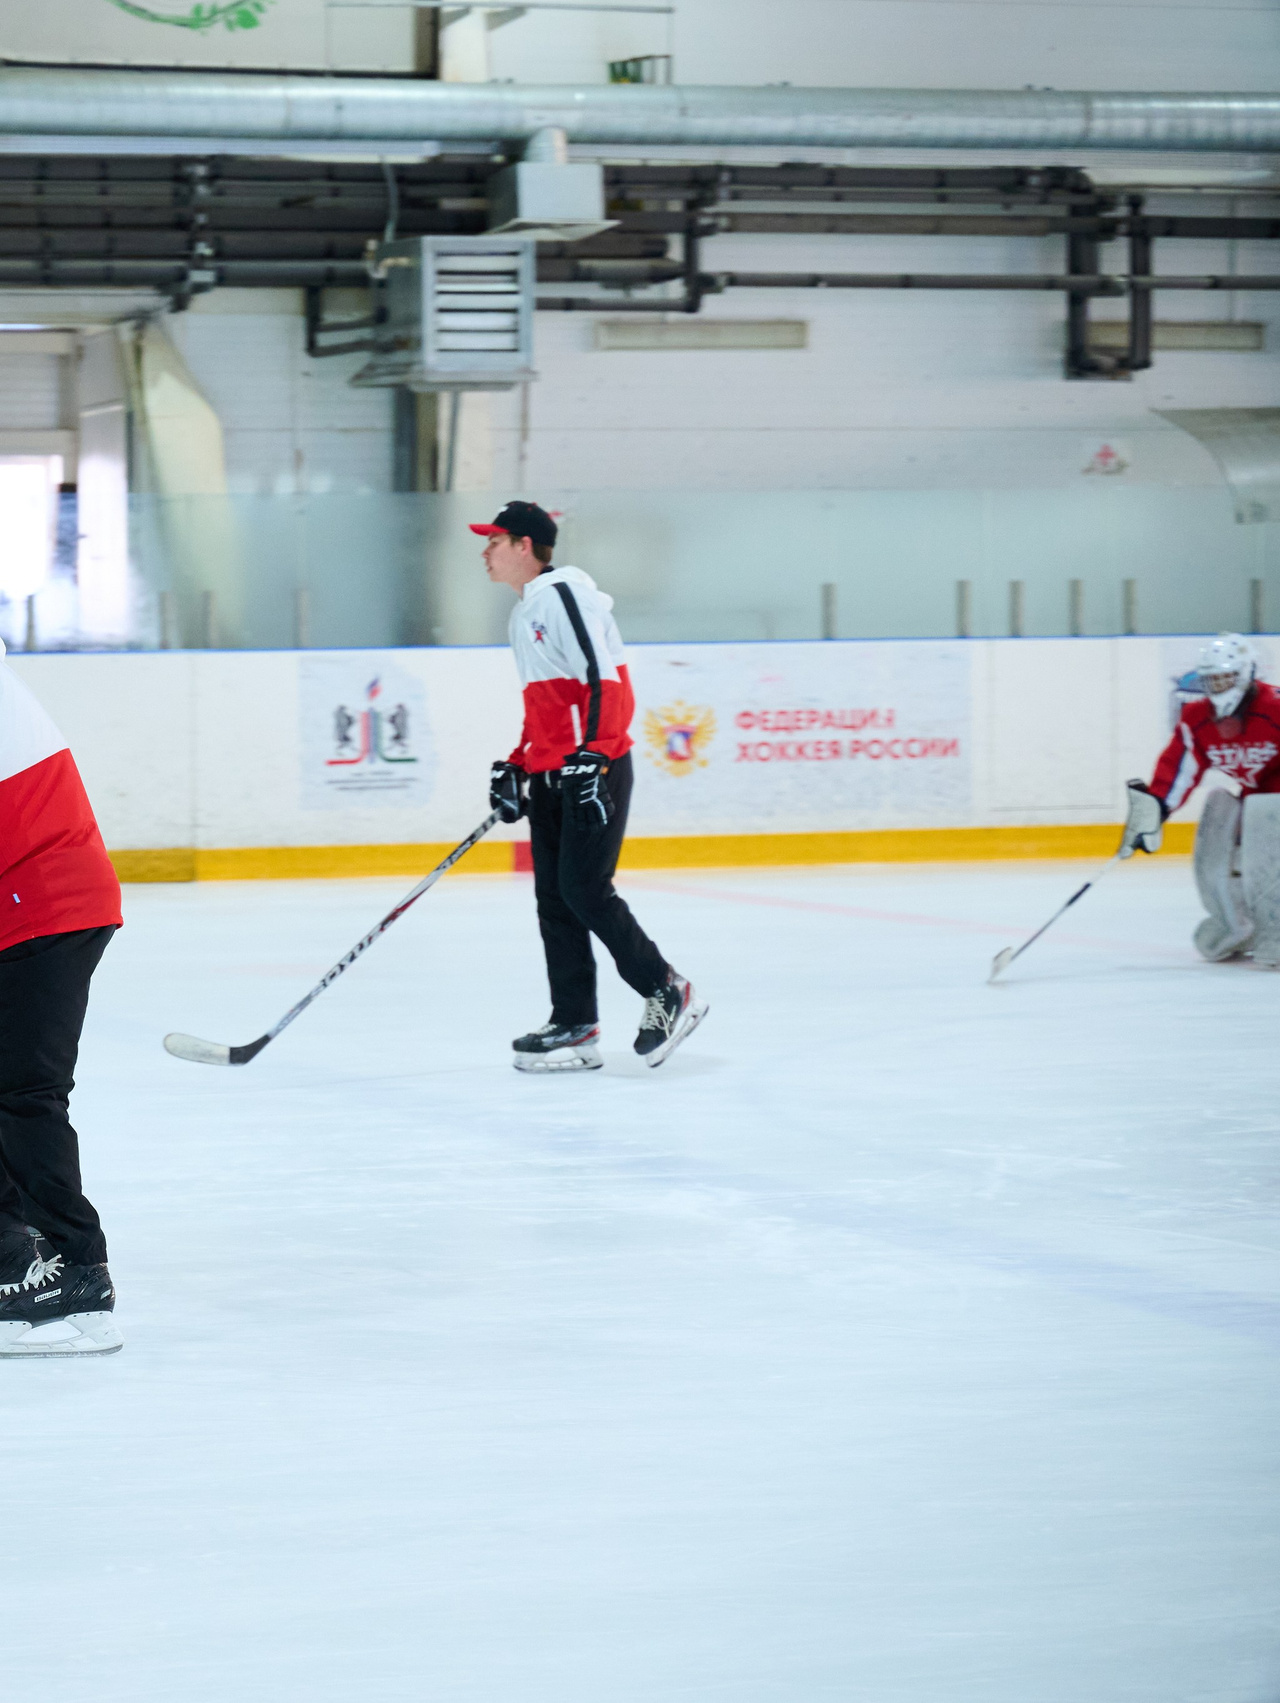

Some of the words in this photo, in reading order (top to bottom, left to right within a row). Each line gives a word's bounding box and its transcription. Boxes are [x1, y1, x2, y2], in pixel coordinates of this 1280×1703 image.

[734, 707, 896, 733] ФЕДЕРАЦИЯ
[734, 739, 842, 763] ХОККЕЯ
[847, 737, 960, 760] РОССИИ
